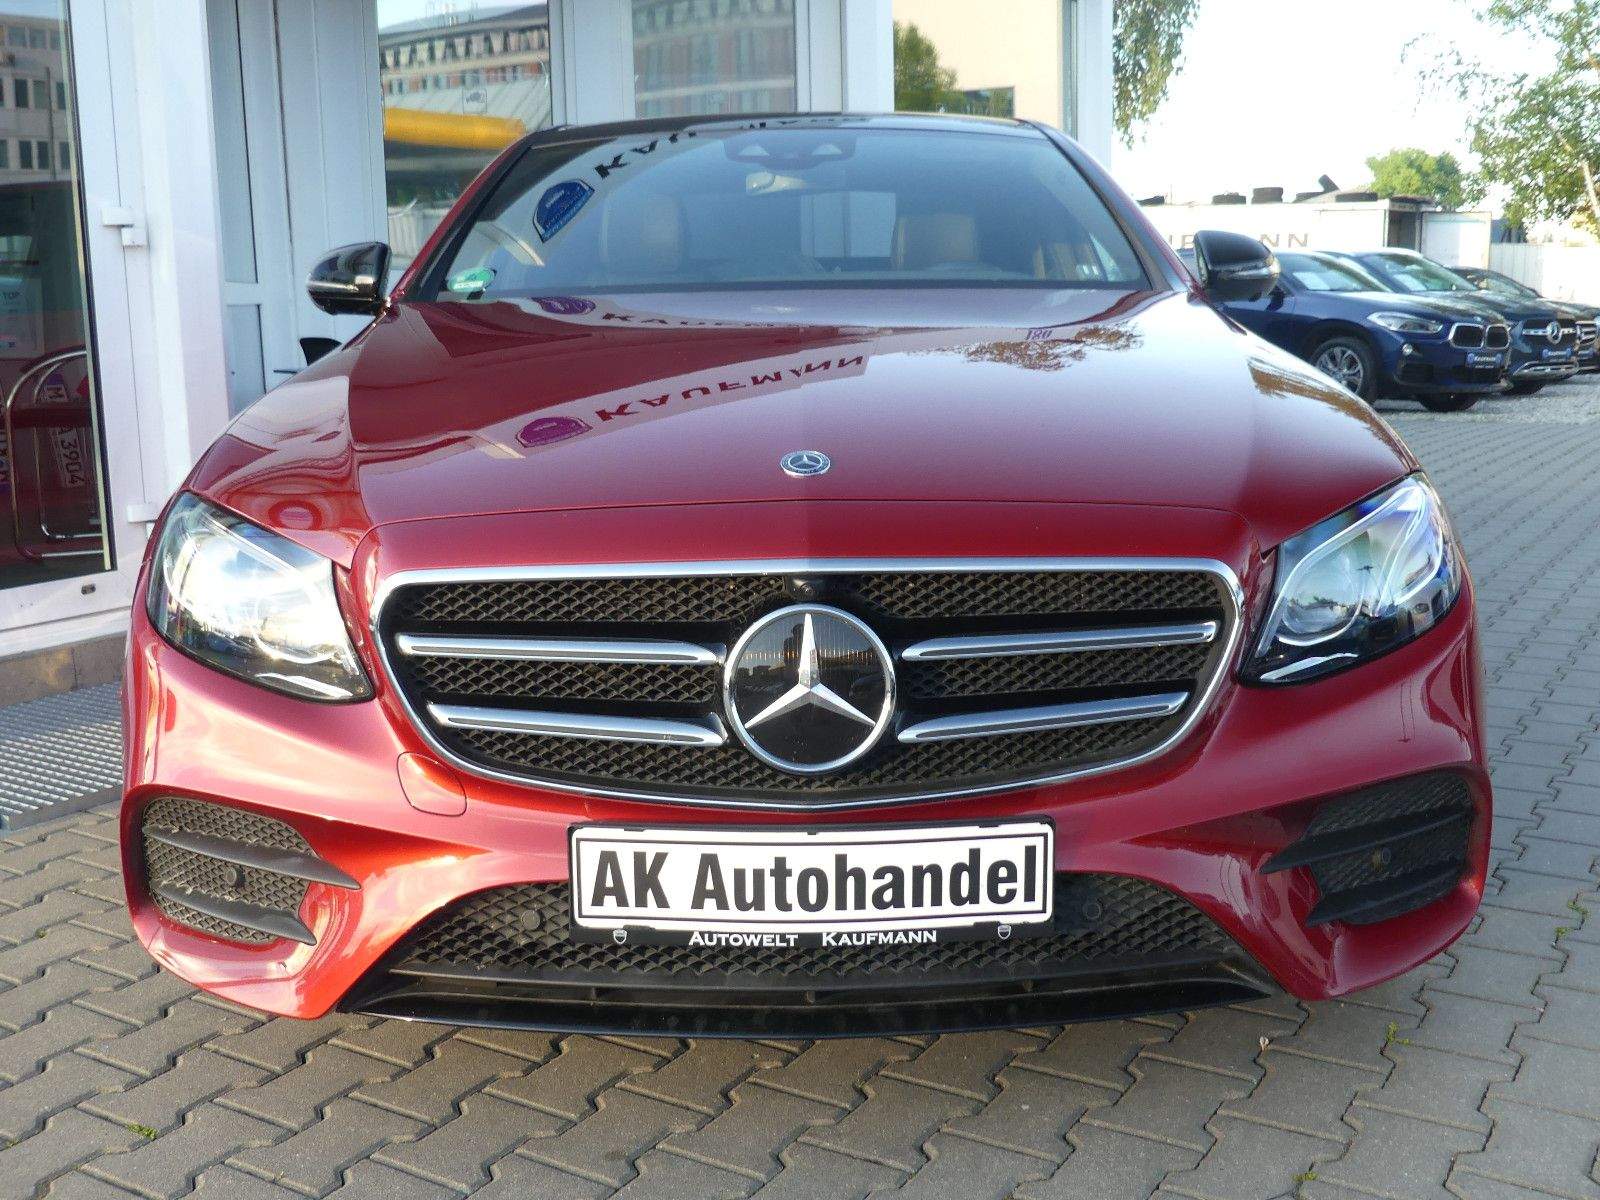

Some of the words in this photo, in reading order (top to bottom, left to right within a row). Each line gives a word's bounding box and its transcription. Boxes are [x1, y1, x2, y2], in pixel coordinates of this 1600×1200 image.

[591, 850, 670, 908] AK
[691, 845, 1036, 912] Autohandel
[689, 931, 798, 947] AUTOWELT
[822, 930, 936, 947] KAUFMANN
